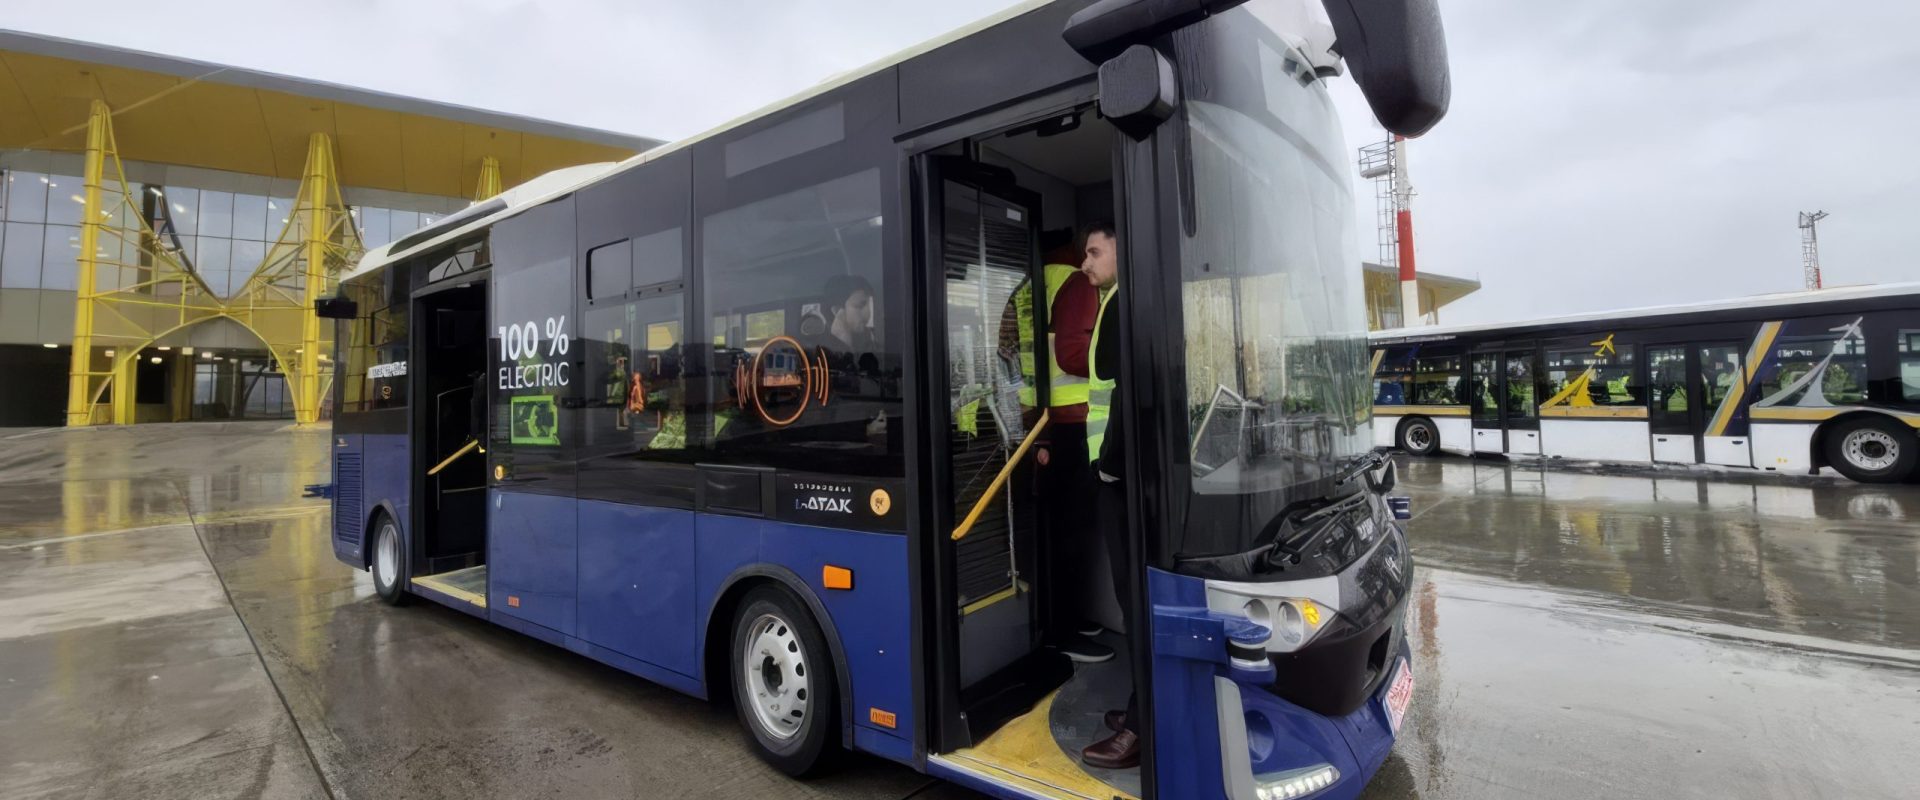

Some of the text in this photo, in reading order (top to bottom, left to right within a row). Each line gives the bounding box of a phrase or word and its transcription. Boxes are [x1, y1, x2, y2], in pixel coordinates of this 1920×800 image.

[498, 315, 569, 362] 100 %
[498, 361, 570, 390] ELECTRIC
